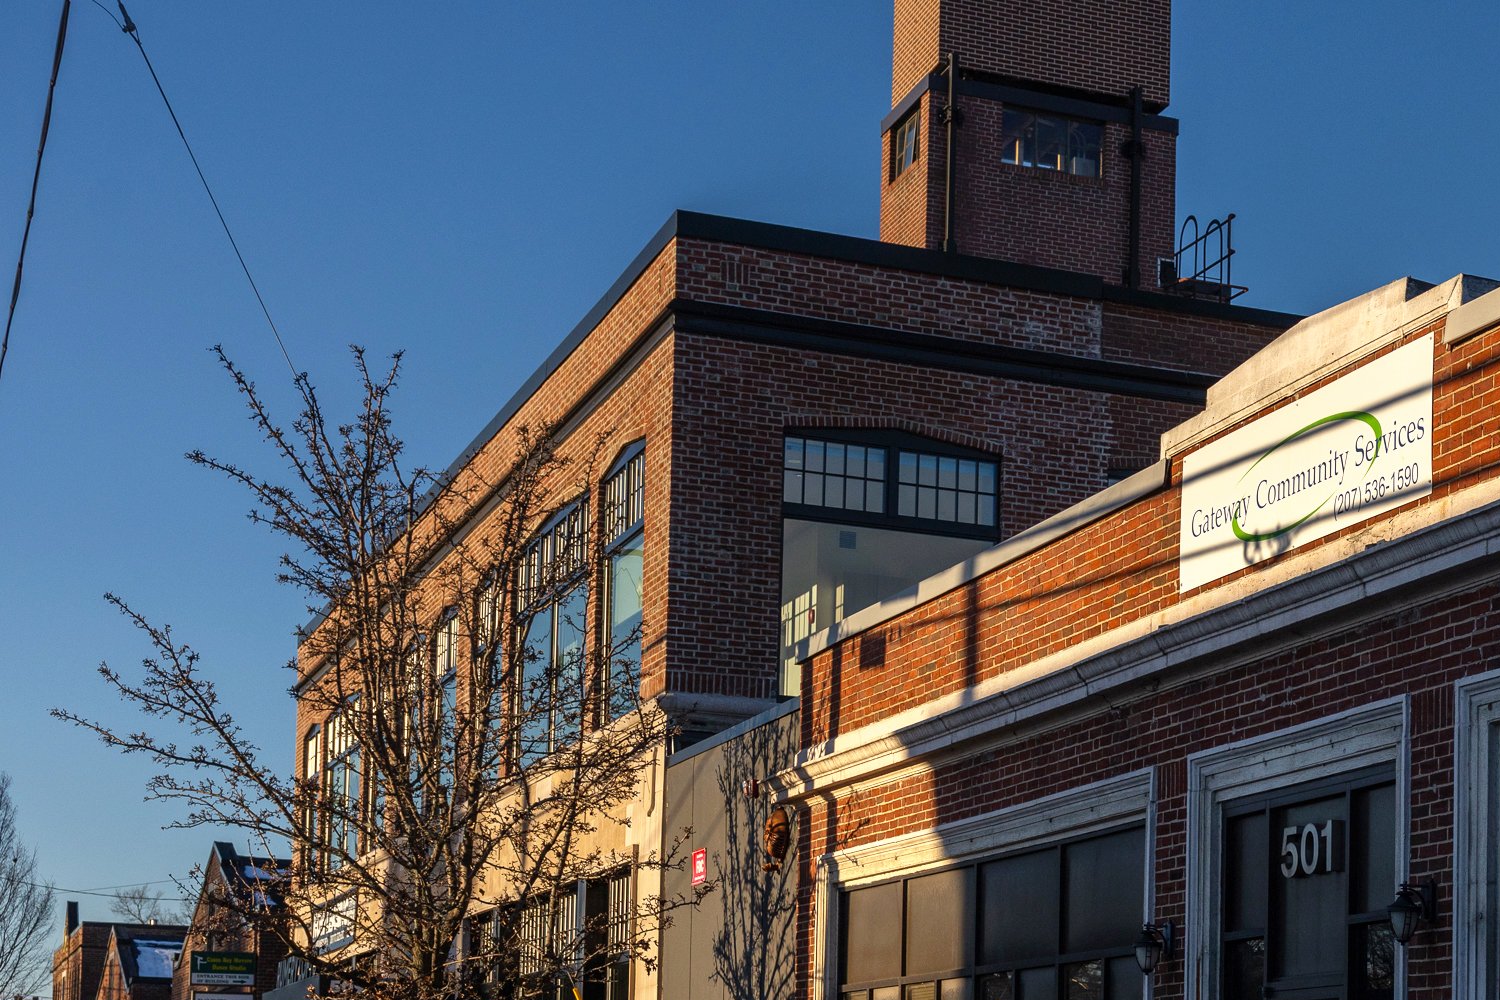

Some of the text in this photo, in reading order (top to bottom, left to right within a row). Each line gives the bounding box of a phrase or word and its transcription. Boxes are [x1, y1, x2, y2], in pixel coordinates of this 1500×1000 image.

[1191, 417, 1425, 538] Gateway Community Services
[1333, 462, 1419, 522] (207) 536-1590
[1281, 819, 1332, 878] 501
